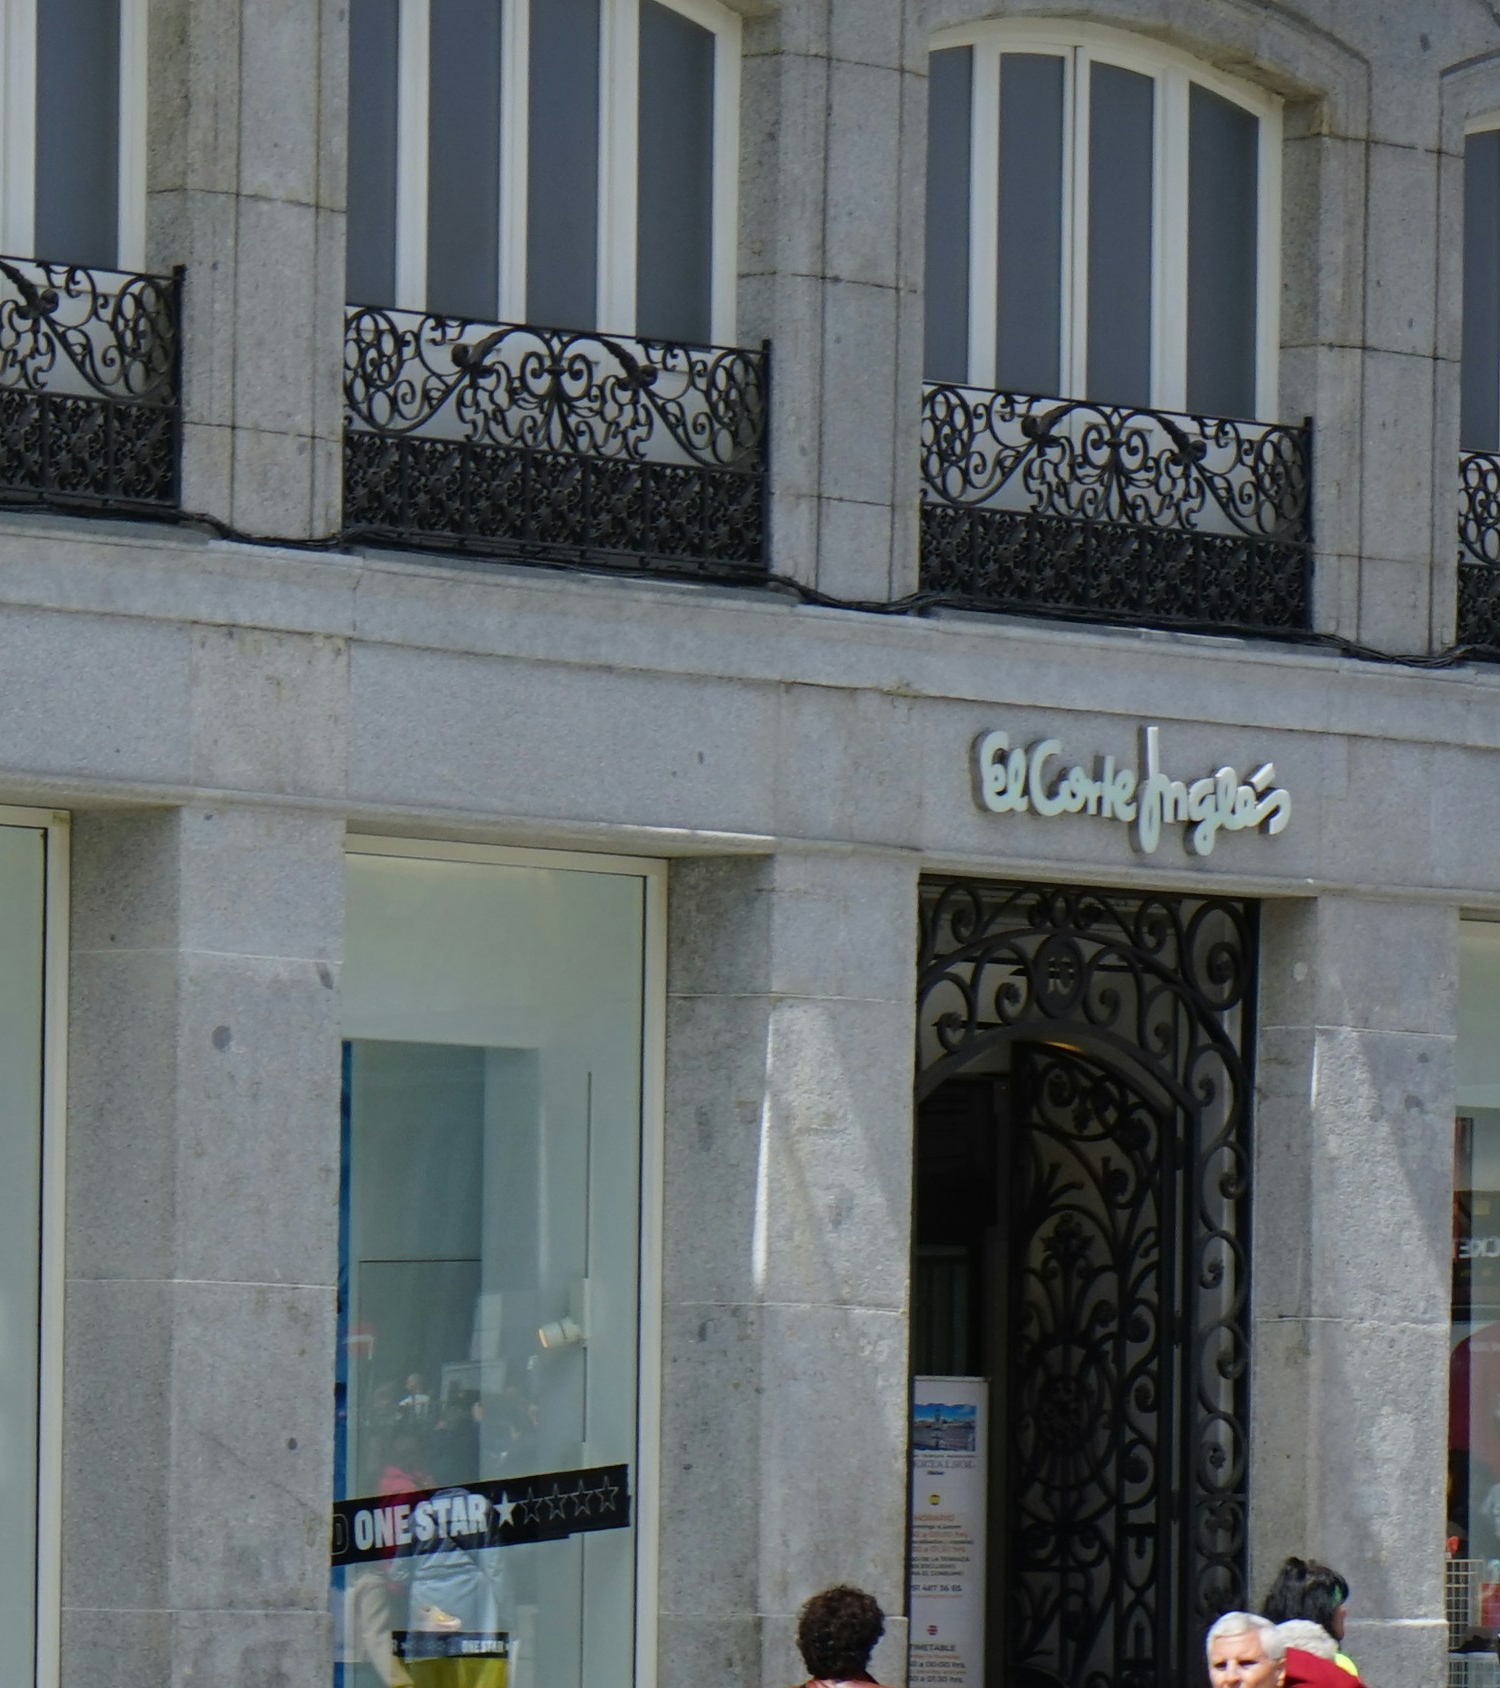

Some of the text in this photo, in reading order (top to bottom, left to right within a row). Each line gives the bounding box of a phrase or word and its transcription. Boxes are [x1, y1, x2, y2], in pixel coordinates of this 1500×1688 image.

[978, 725, 1292, 857] El Corte Inglés
[354, 1493, 489, 1550] ONE STAR
